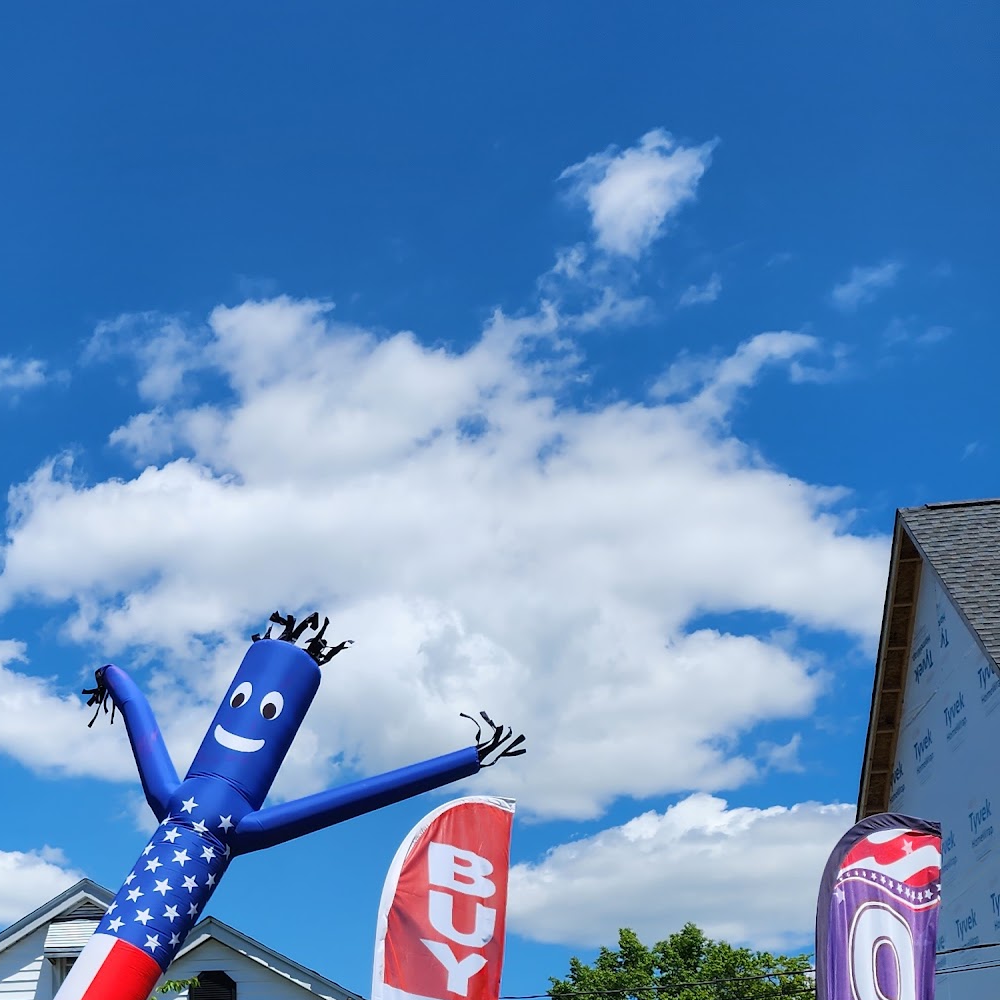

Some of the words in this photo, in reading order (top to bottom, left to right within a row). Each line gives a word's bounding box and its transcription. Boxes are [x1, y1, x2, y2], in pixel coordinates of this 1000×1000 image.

[914, 649, 933, 684] Tyvek
[943, 691, 965, 728] Tyvek
[914, 728, 933, 762] Tyvek
[968, 798, 992, 834] Tyvek
[420, 841, 497, 997] BUY
[955, 908, 977, 941] Tyvek
